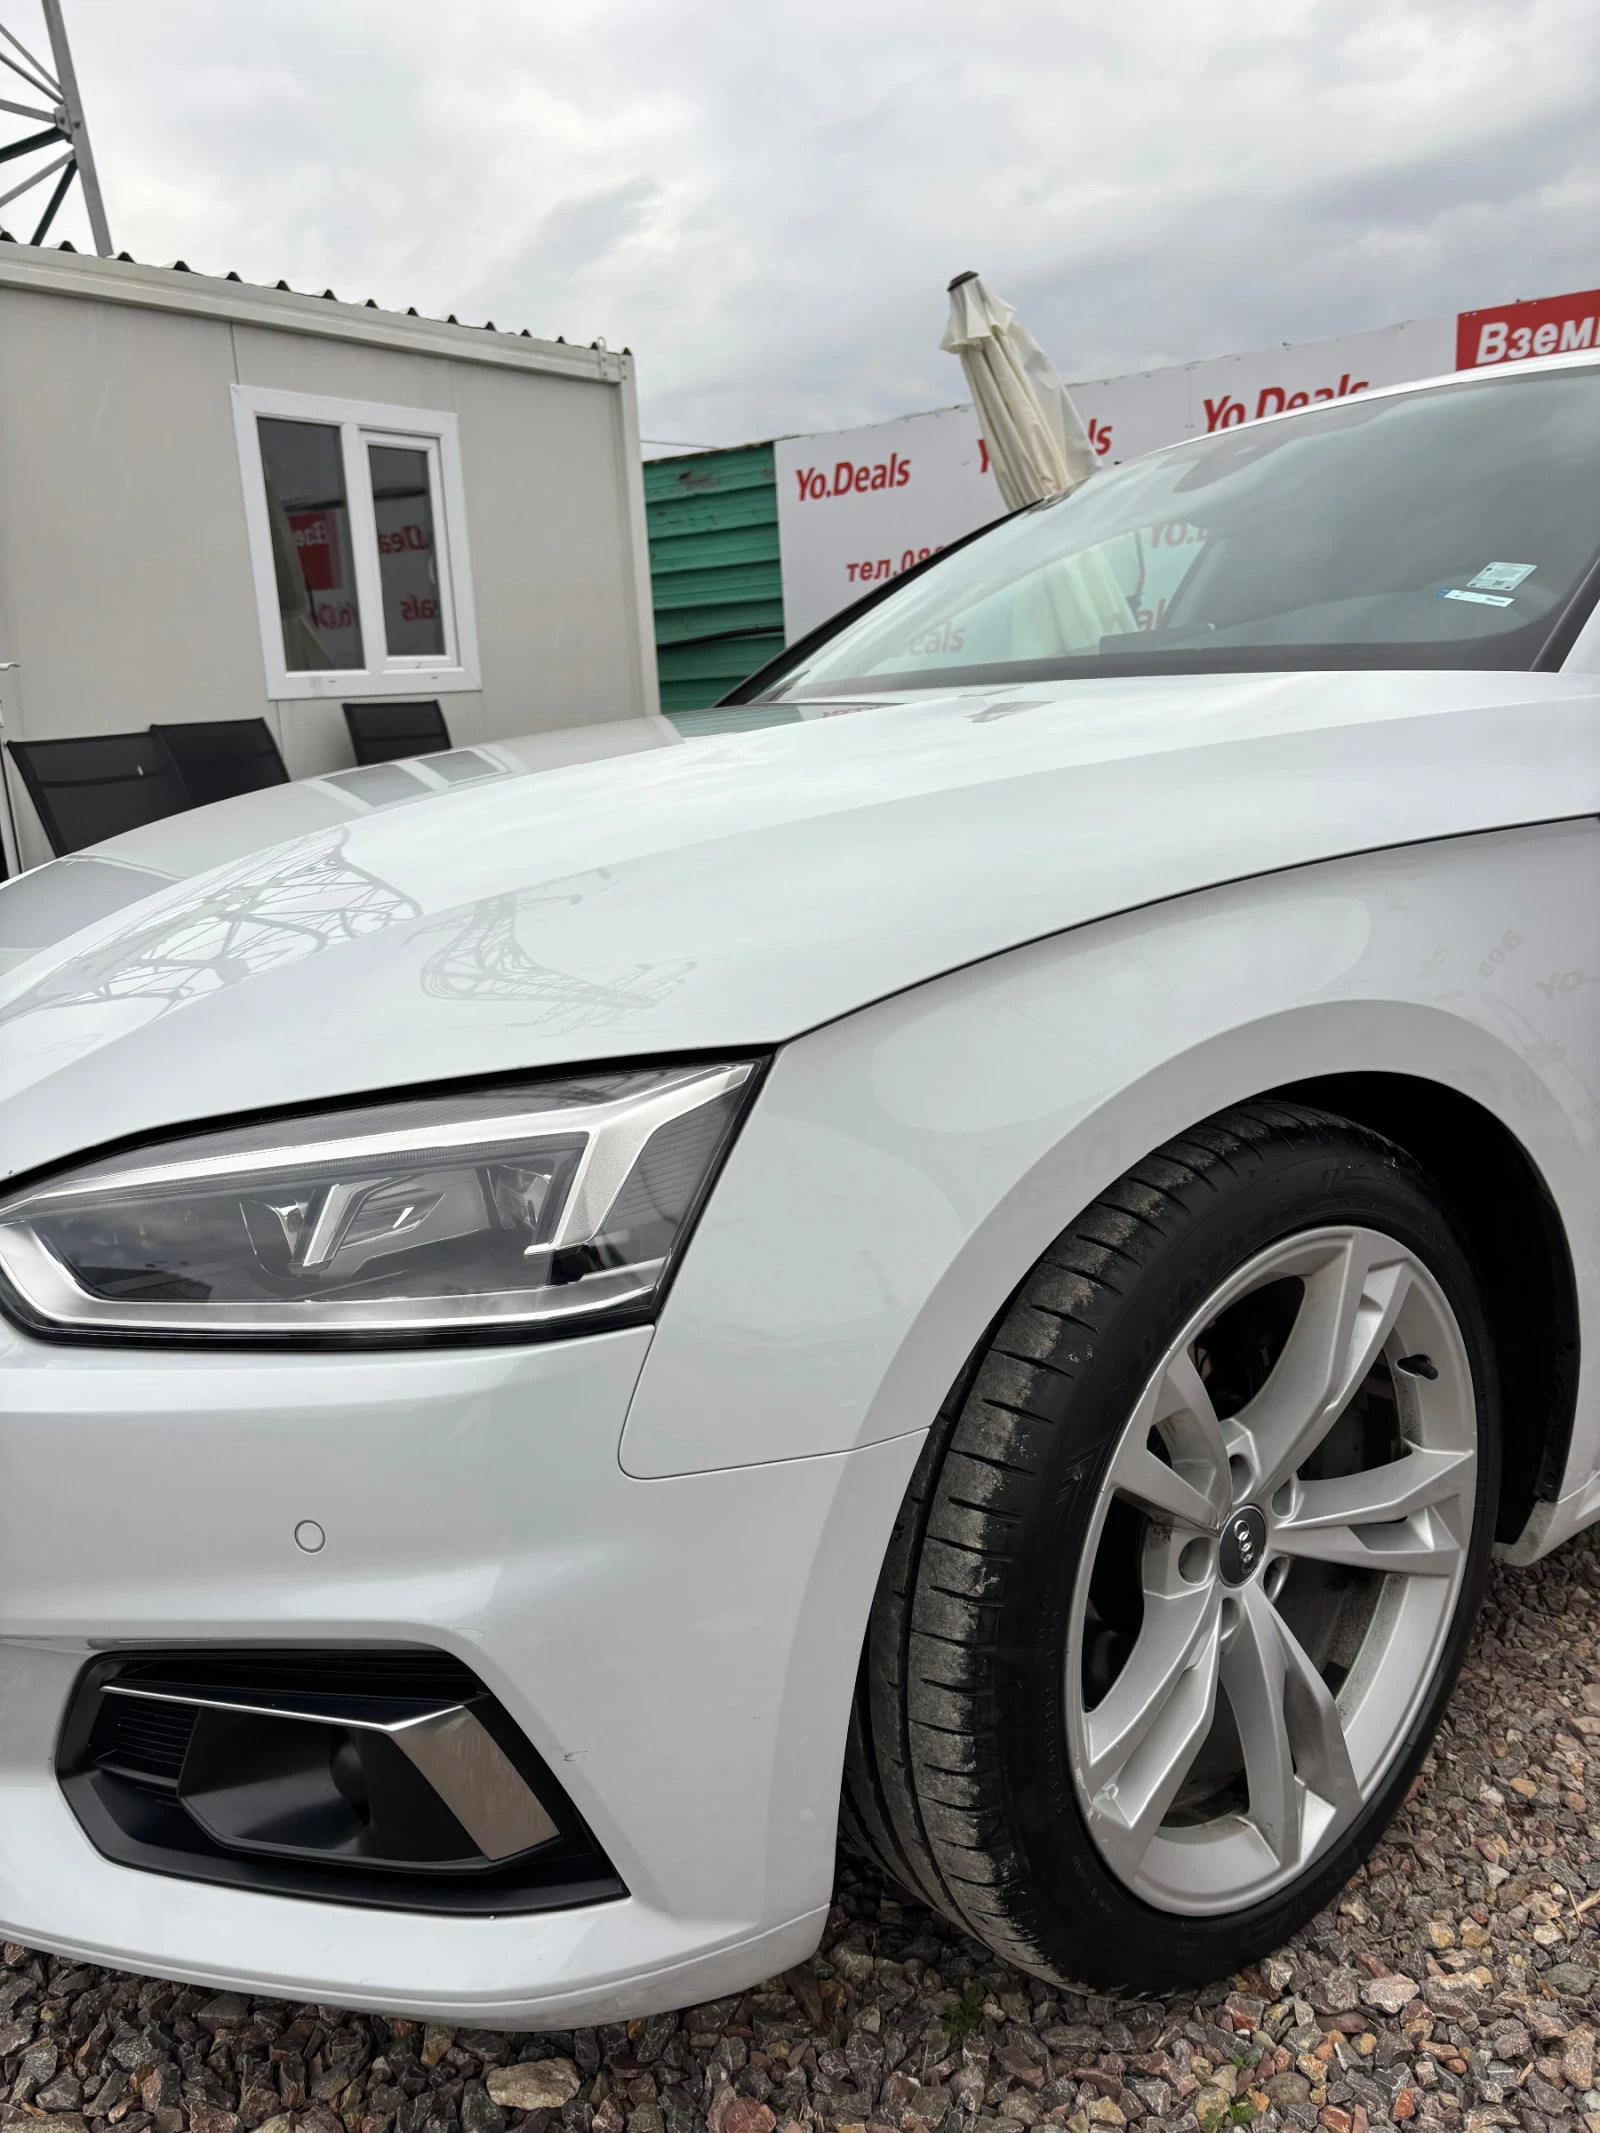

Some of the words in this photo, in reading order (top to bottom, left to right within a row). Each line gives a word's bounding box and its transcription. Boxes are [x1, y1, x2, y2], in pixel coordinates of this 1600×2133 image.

[1475, 316, 1600, 365] Взем
[795, 452, 912, 501] Yo.Deals
[846, 545, 944, 582] тел.08
